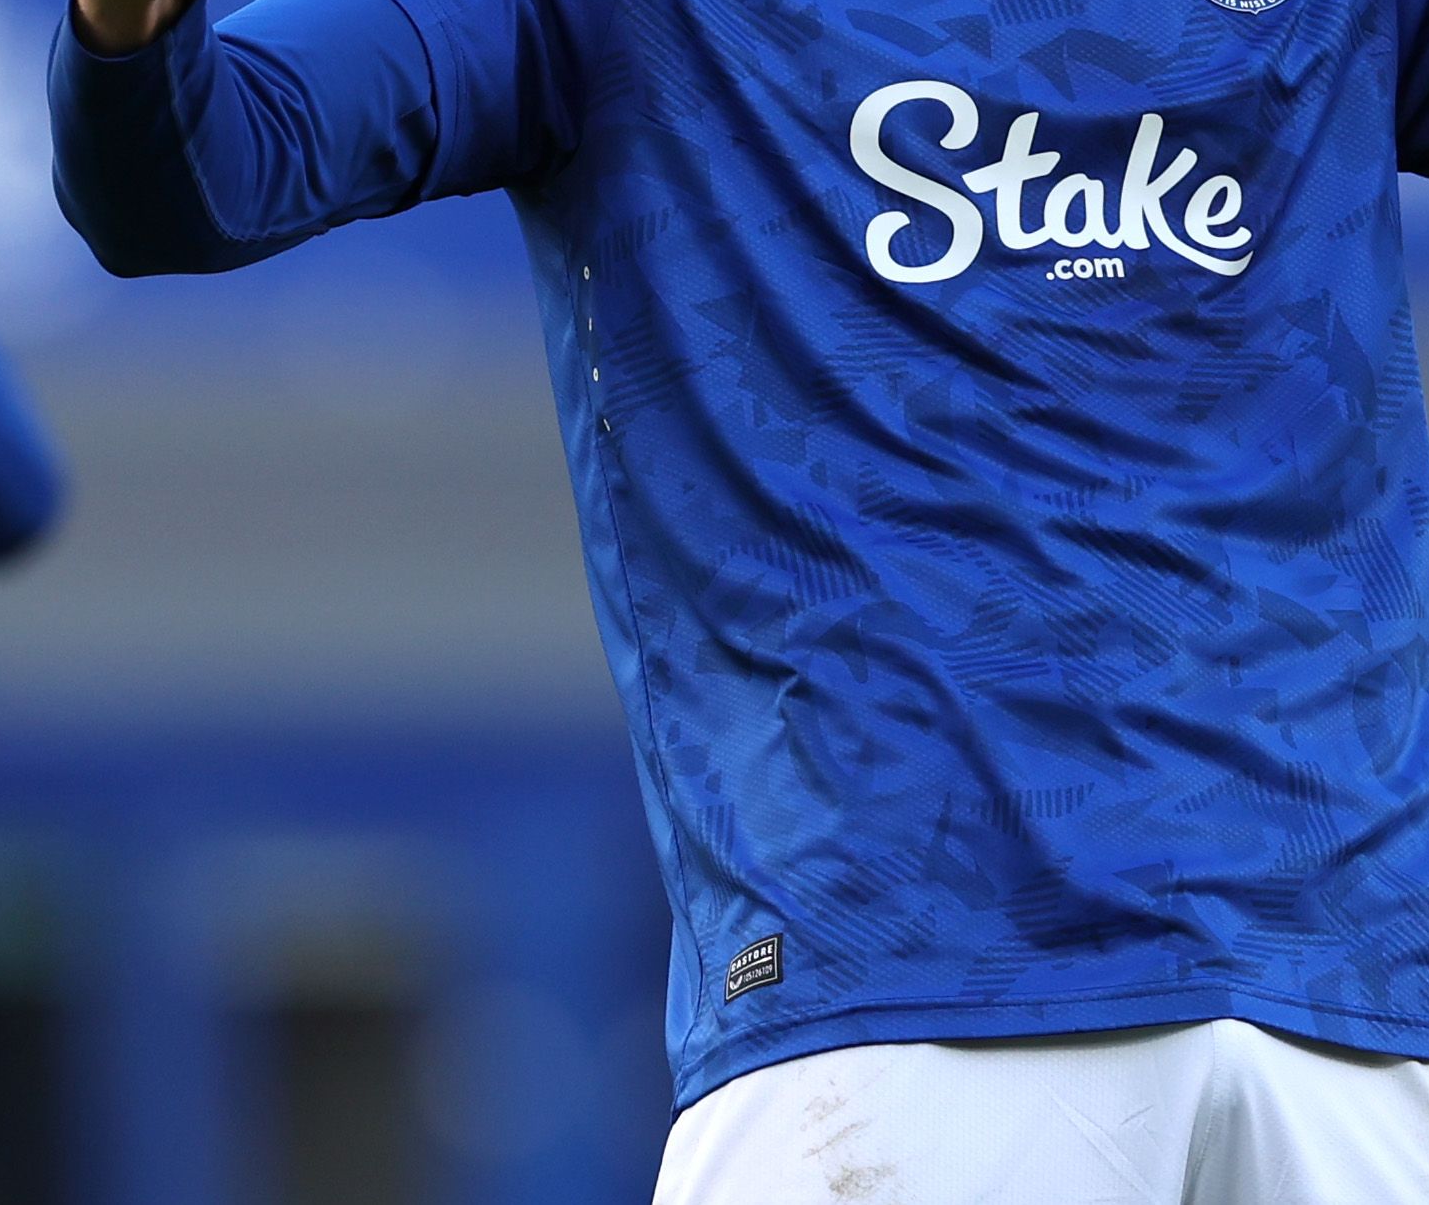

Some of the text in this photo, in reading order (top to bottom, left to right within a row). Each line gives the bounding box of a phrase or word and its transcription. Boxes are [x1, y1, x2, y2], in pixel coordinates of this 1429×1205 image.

[849, 80, 1255, 284] Stake
[1045, 253, 1126, 282] .com
[731, 944, 773, 972] CASTORE
